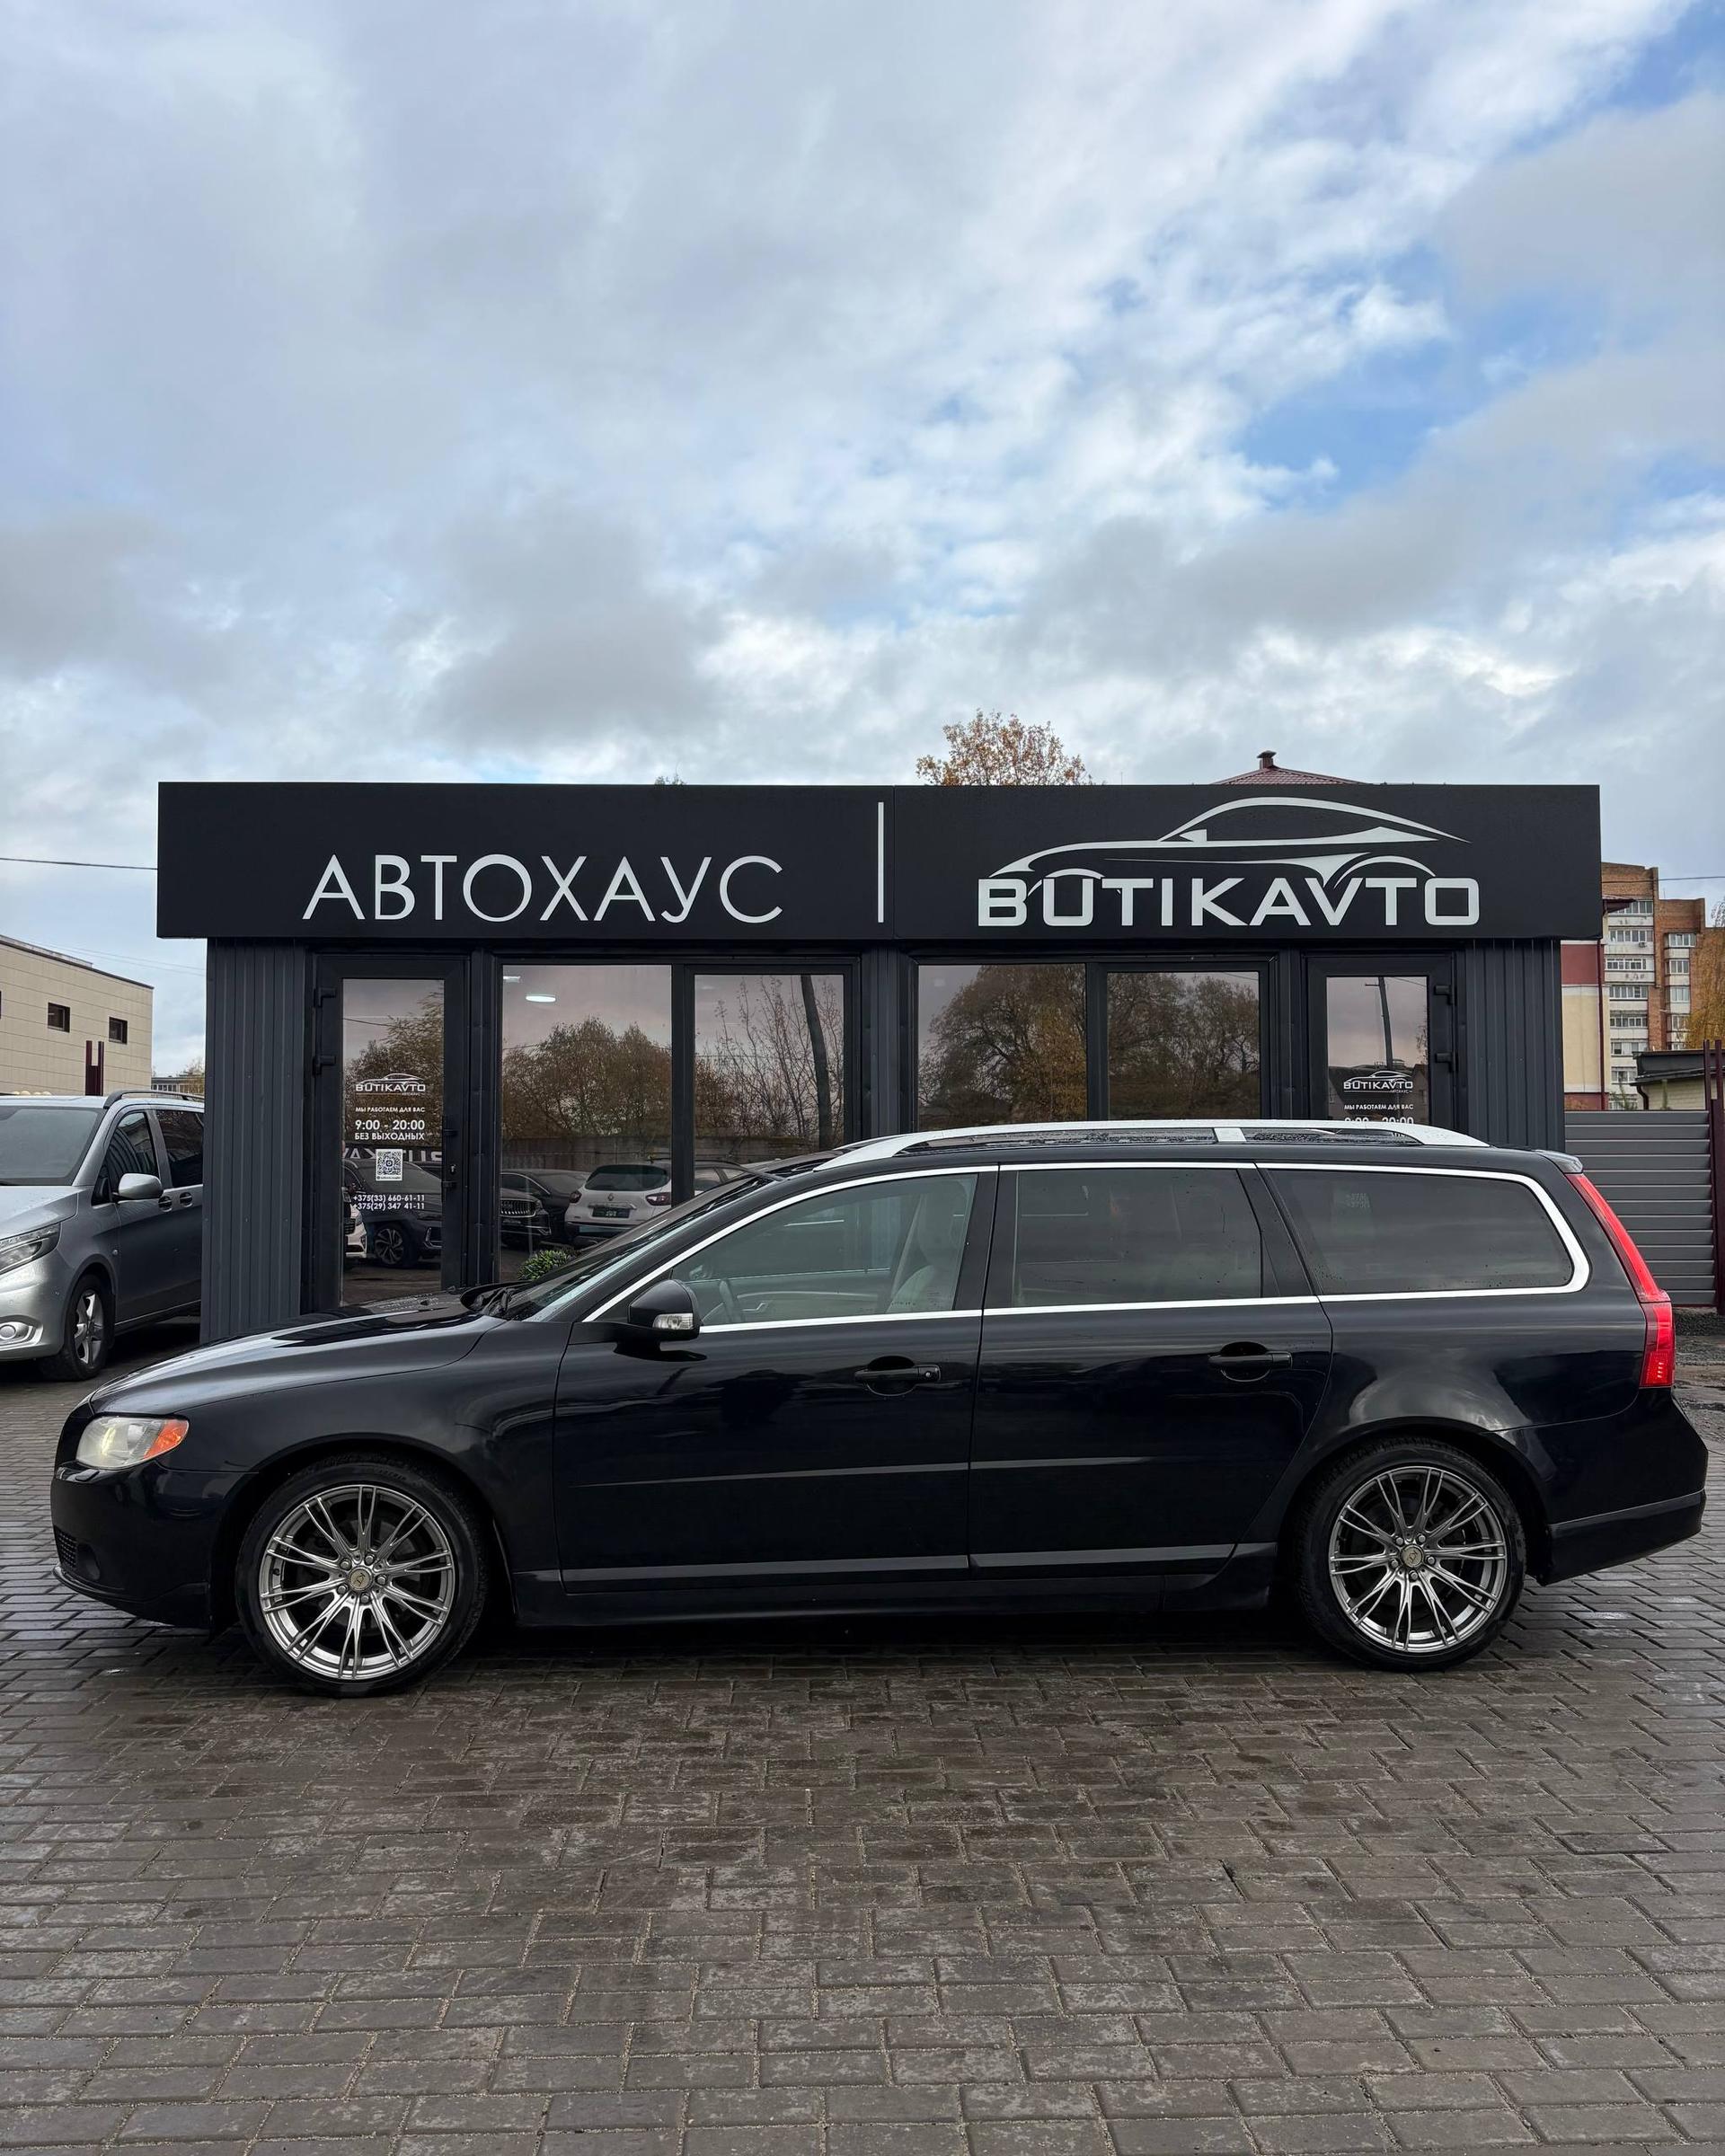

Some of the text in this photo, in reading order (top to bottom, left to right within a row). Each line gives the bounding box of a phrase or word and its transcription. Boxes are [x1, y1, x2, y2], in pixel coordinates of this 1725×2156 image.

[302, 854, 783, 923] АВТОХАУС
[978, 877, 1480, 927] BUTIKAVTO
[355, 1083, 426, 1092] BUTIKAVTO
[1343, 1081, 1413, 1090] BUTIKAVTO
[355, 1119, 380, 1130] 9:00
[392, 1119, 425, 1130] 20:00
[354, 1132, 425, 1141] БЕЗ ВЫХОДНЫХ
[352, 1194, 425, 1203] +375(33) 660-61-11
[352, 1202, 425, 1211] +375(29) 347 41-11
